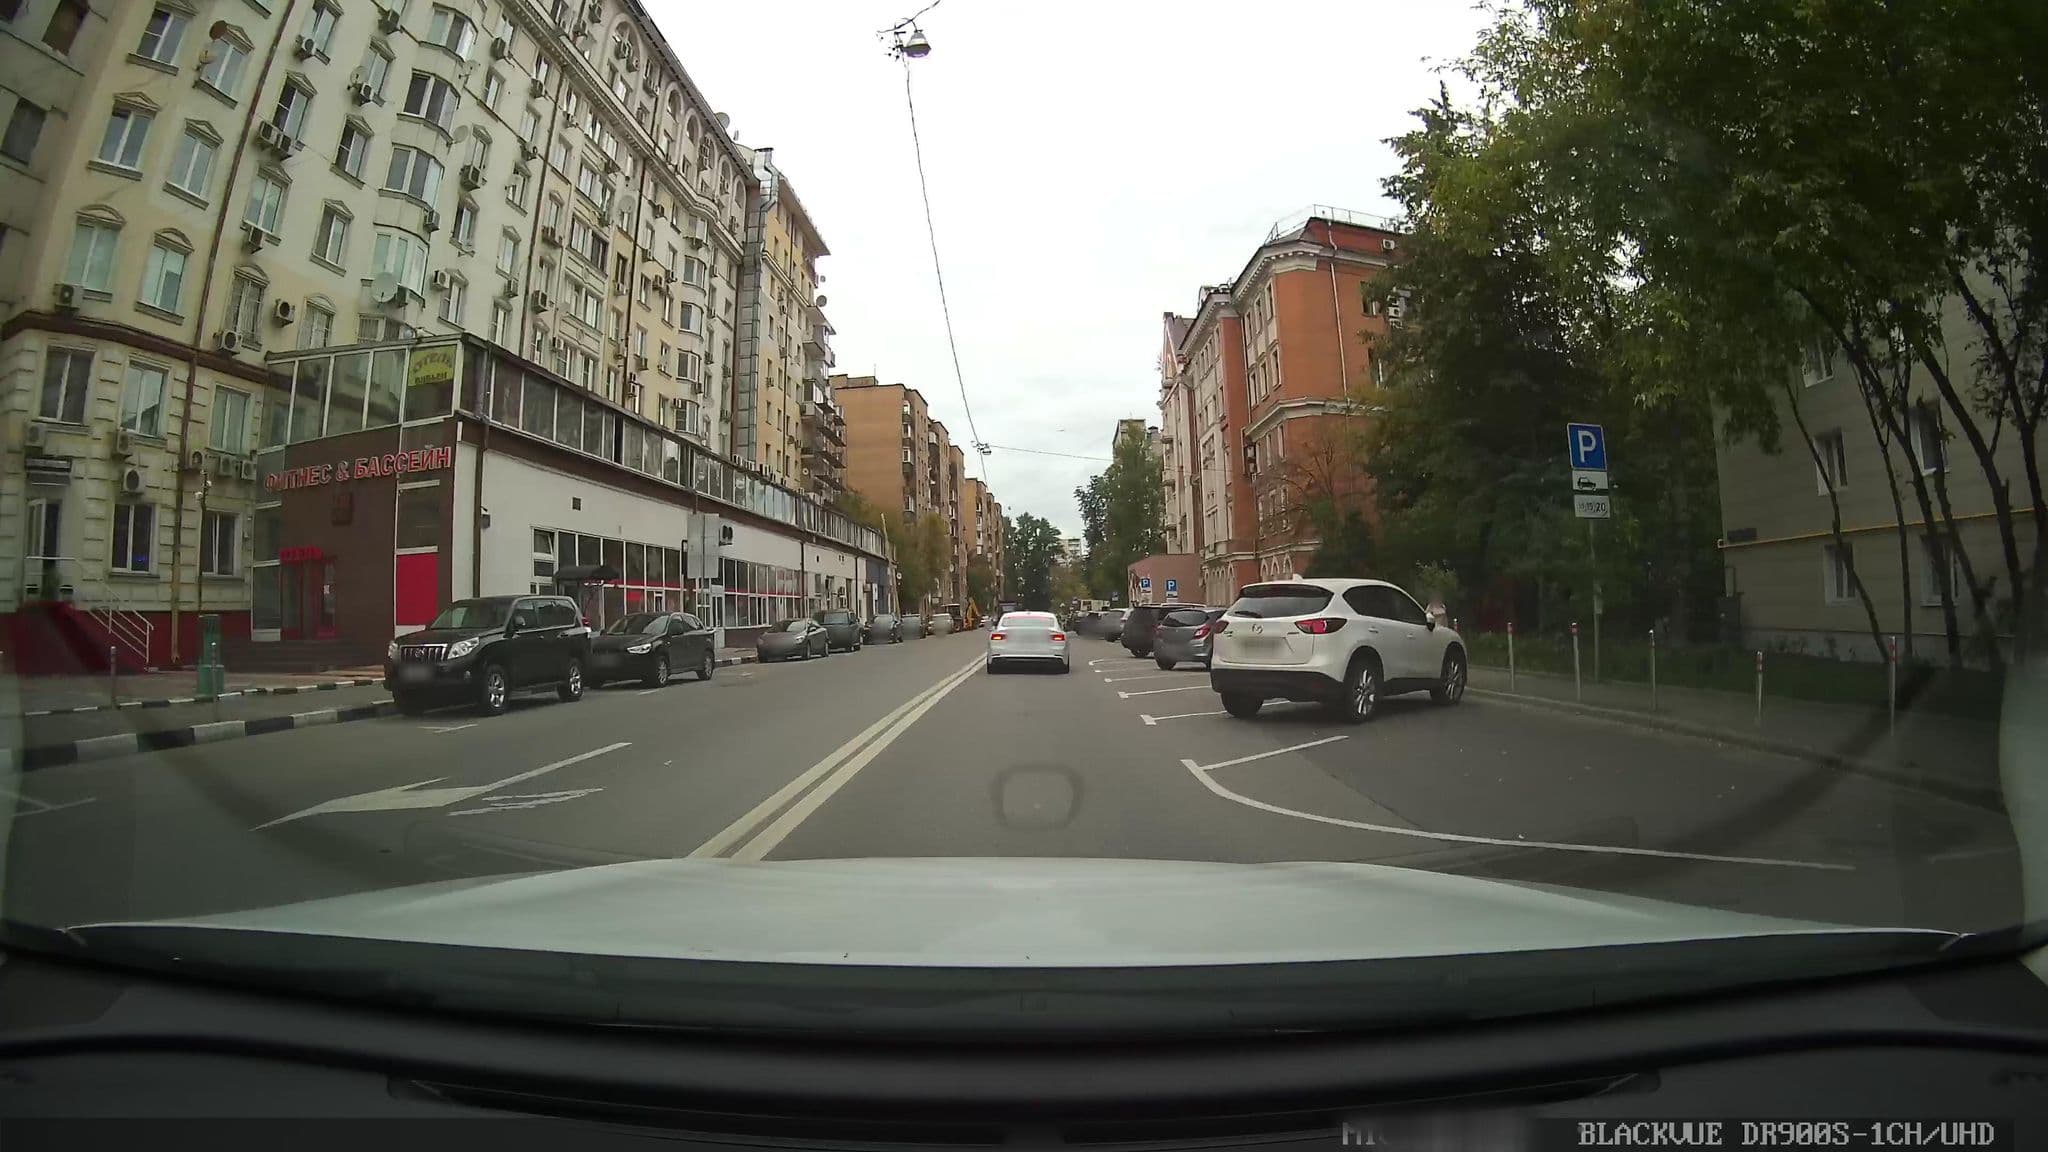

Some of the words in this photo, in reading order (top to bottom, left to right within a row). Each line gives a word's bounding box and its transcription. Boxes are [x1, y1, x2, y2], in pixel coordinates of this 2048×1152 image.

[1577, 430, 1596, 463] P
[265, 464, 332, 492] ФИТНЕС
[336, 460, 351, 481] &
[354, 445, 452, 479] БАССЕЙН
[1167, 580, 1175, 591] P
